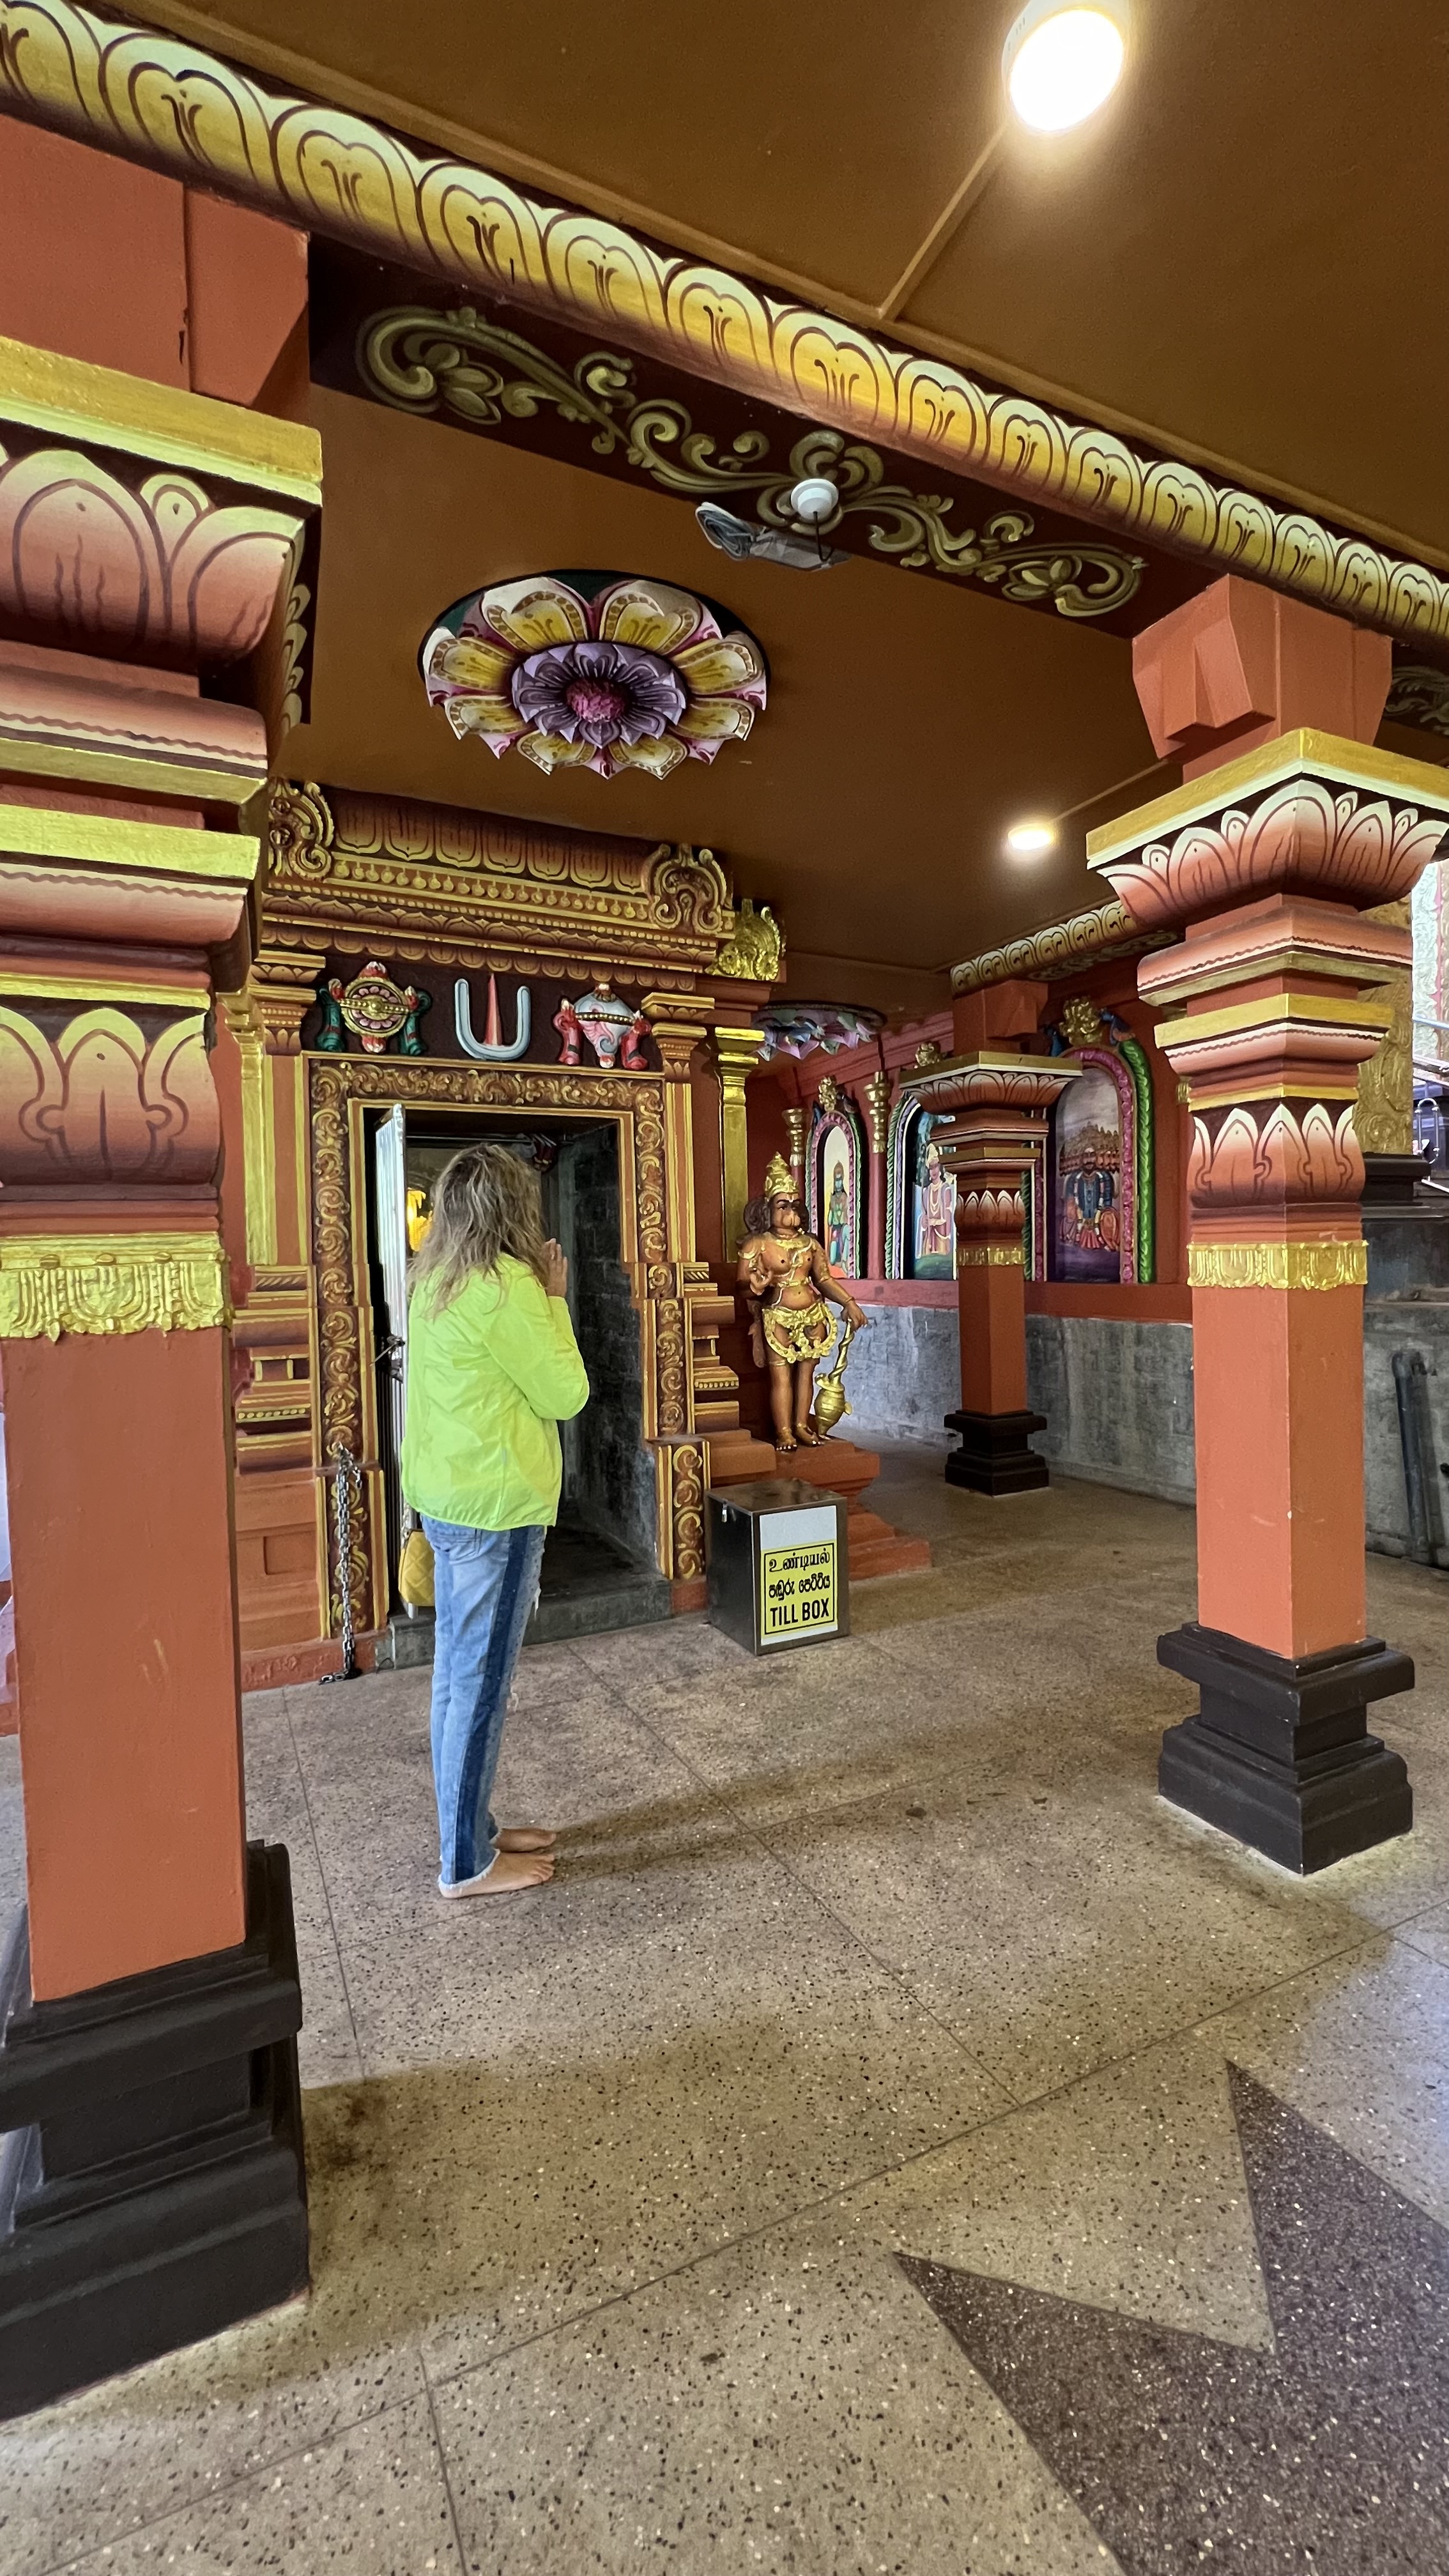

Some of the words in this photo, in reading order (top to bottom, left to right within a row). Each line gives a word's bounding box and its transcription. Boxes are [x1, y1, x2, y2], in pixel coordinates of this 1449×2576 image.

[769, 1547, 830, 1572] உண்டியல்
[770, 1604, 798, 1627] TILL
[802, 1597, 829, 1621] BOX
